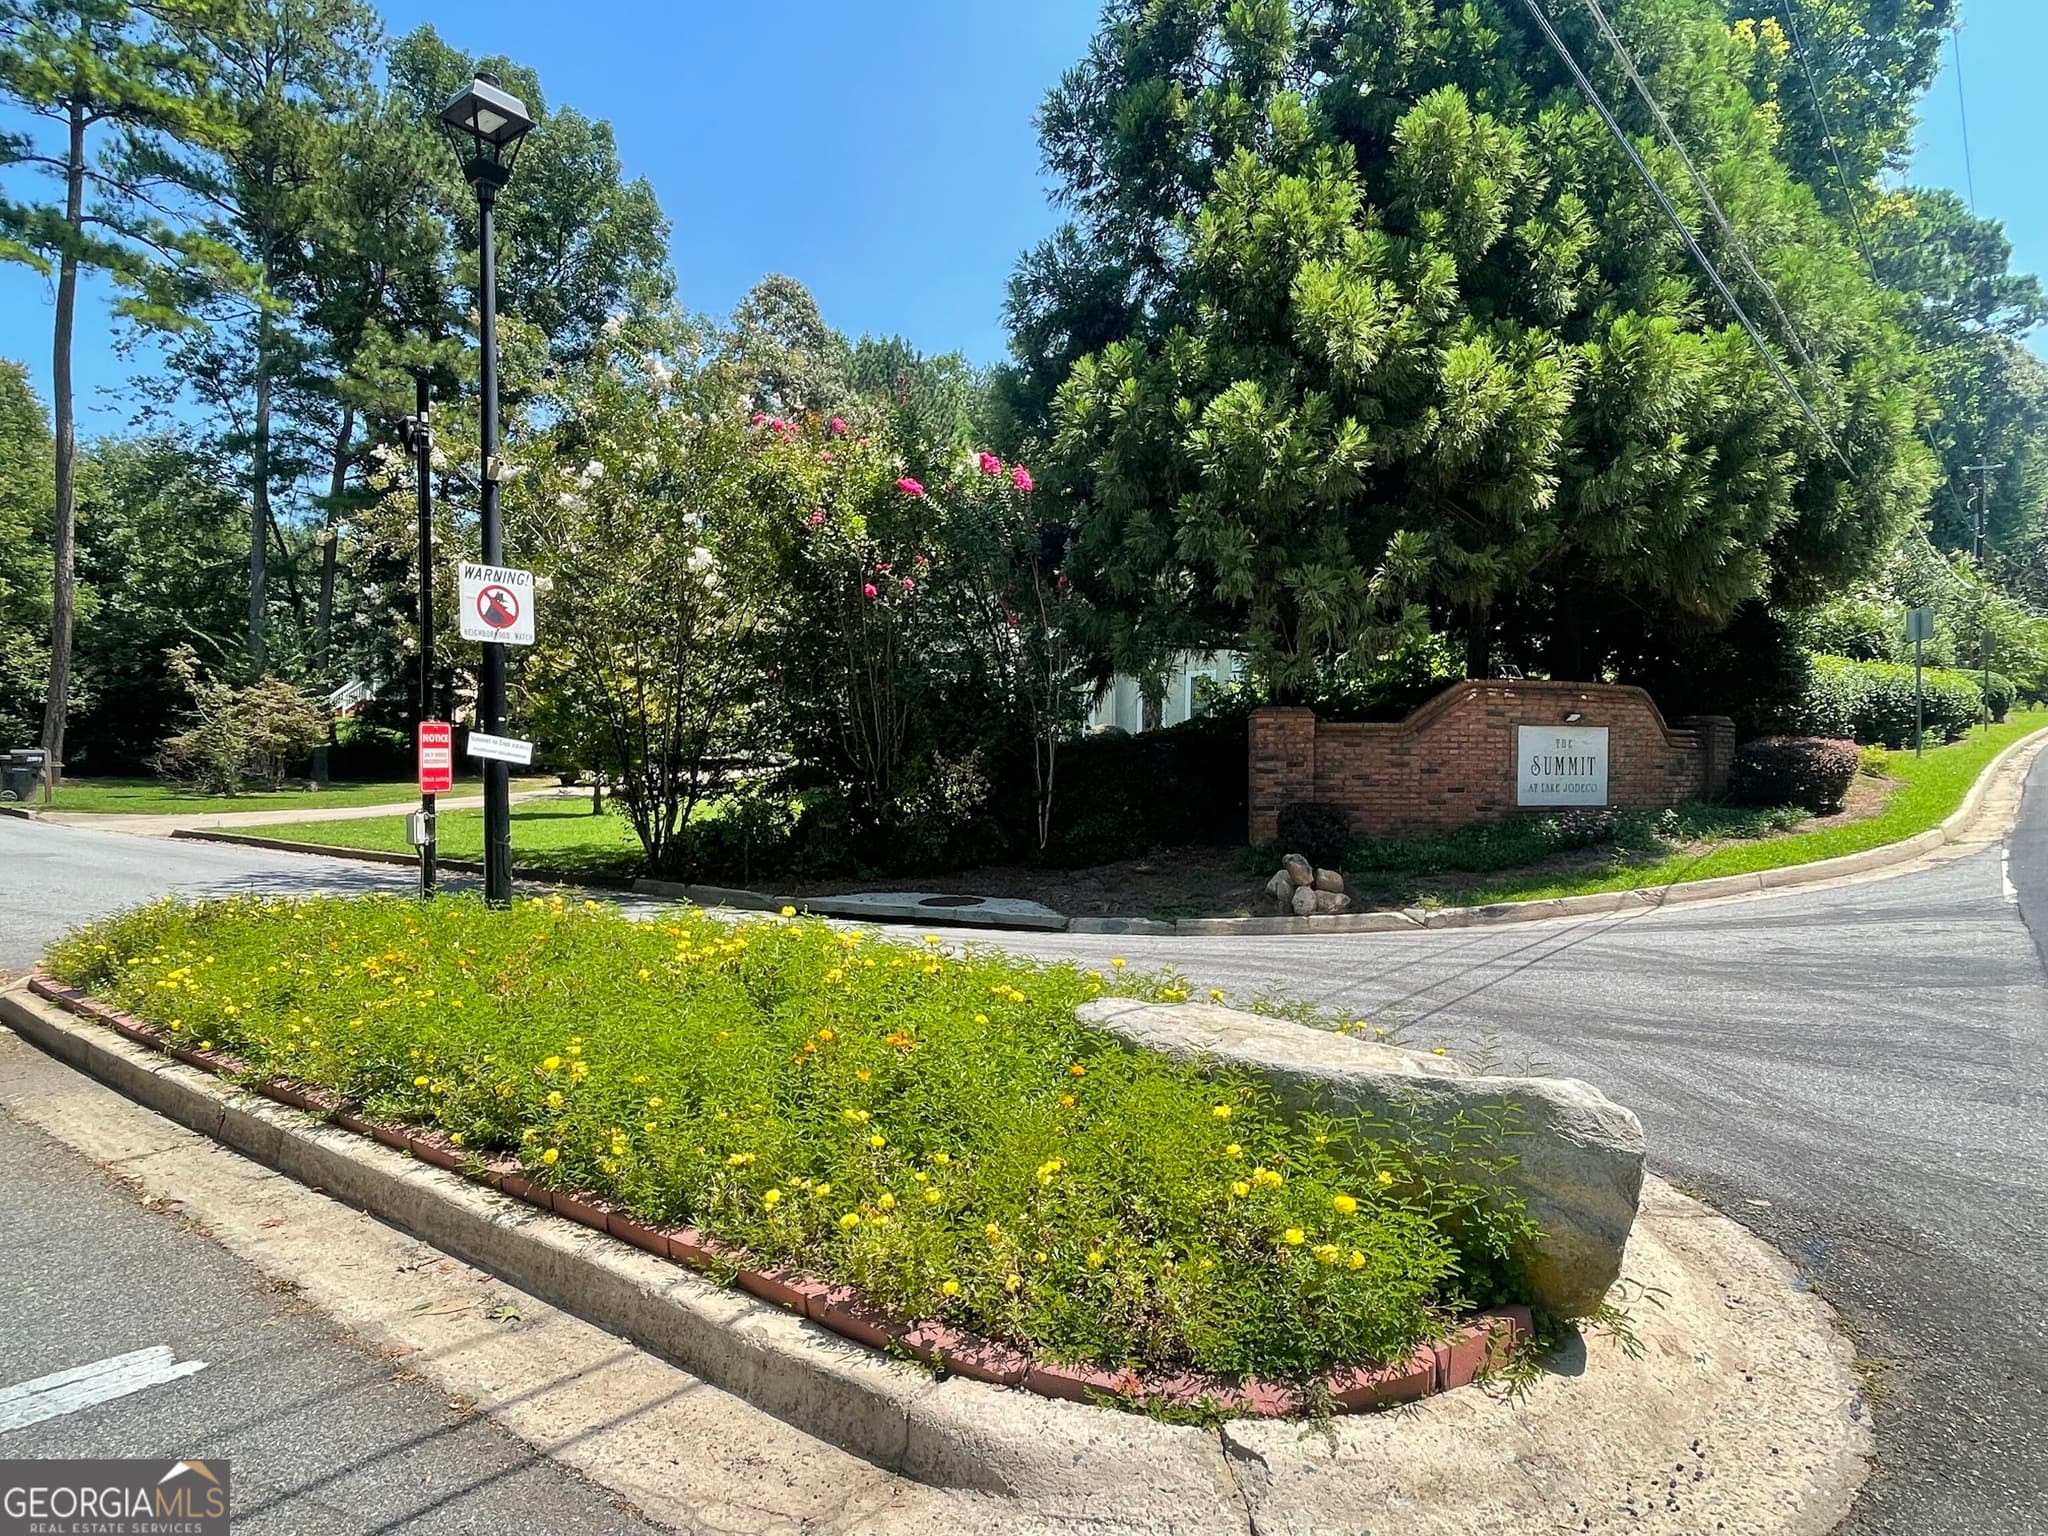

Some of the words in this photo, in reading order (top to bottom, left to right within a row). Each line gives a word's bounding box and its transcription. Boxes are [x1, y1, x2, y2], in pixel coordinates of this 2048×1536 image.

[464, 566, 530, 587] WARNING!
[464, 628, 510, 640] NEIGHBOROOD
[515, 633, 533, 641] WATCH
[423, 734, 449, 743] NOTICE
[1555, 739, 1573, 748] THE
[1530, 755, 1596, 776] SUMMIT
[1528, 783, 1538, 793] AT
[1541, 783, 1560, 793] LAKE
[1563, 783, 1598, 793] JODECO
